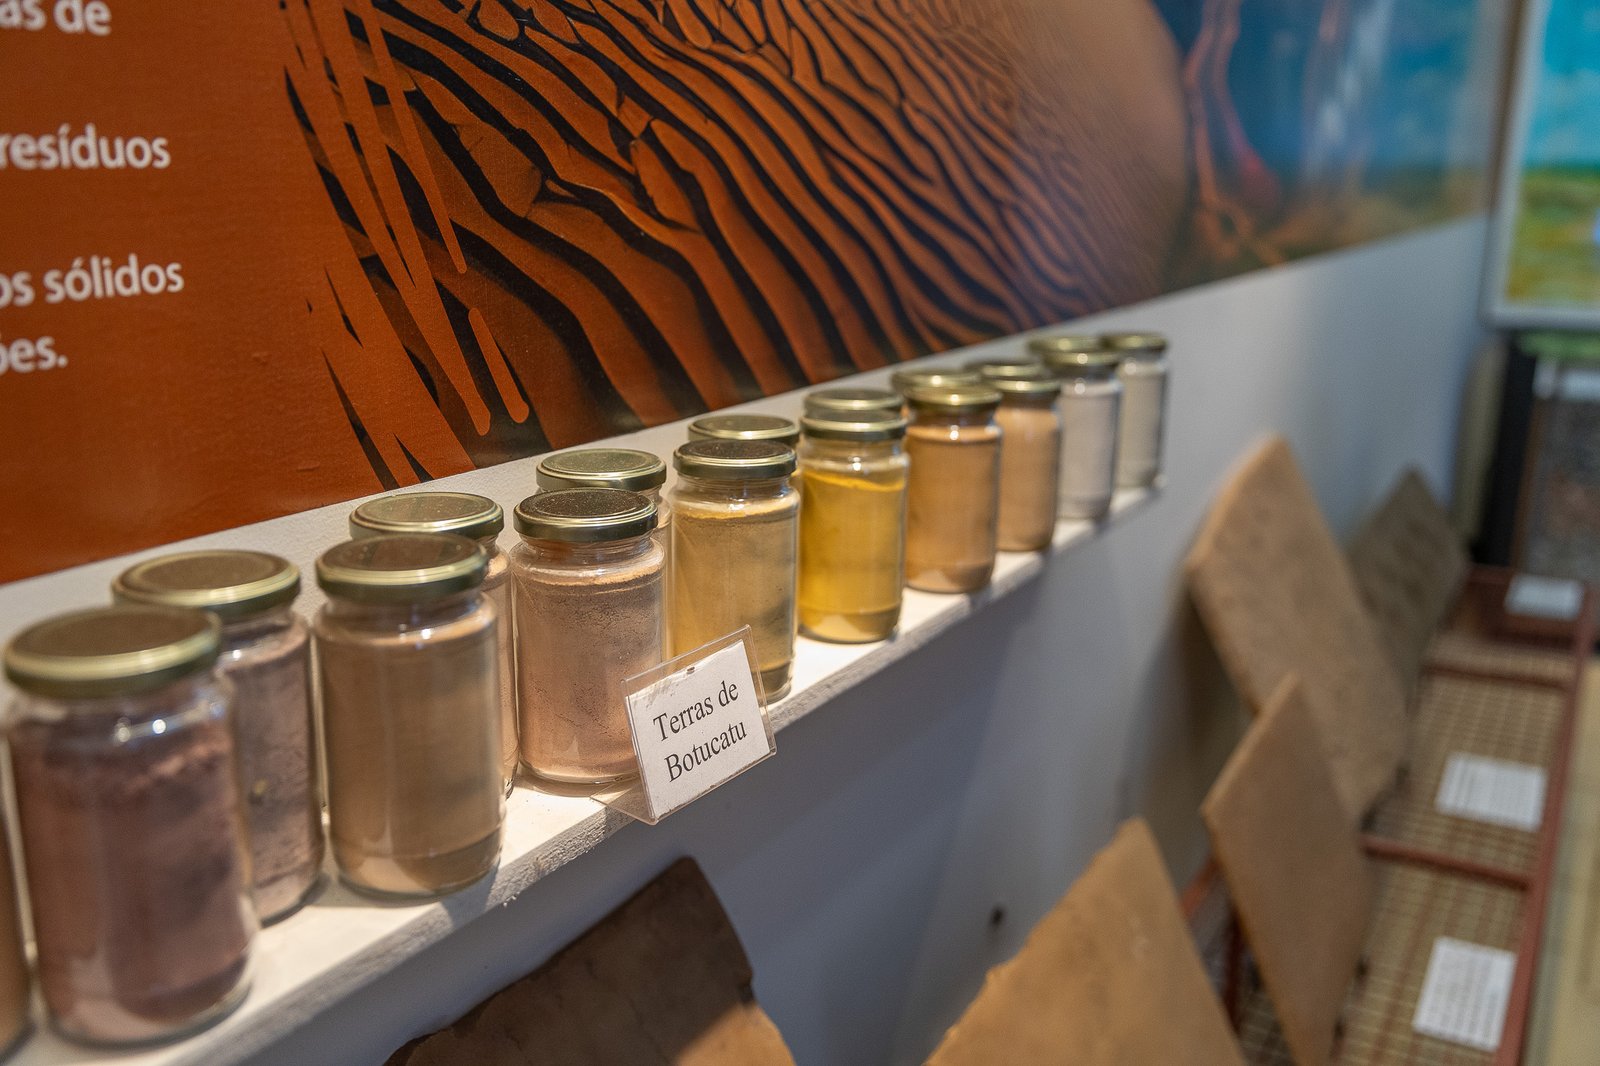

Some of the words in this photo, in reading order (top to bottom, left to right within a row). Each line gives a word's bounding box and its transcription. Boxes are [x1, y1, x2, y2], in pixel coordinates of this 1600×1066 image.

[54, 0, 112, 35] de
[0, 122, 171, 169] resíduos
[44, 253, 184, 303] sólidos
[653, 696, 714, 741] Terras
[718, 680, 739, 707] de
[664, 722, 747, 782] Botucatu
